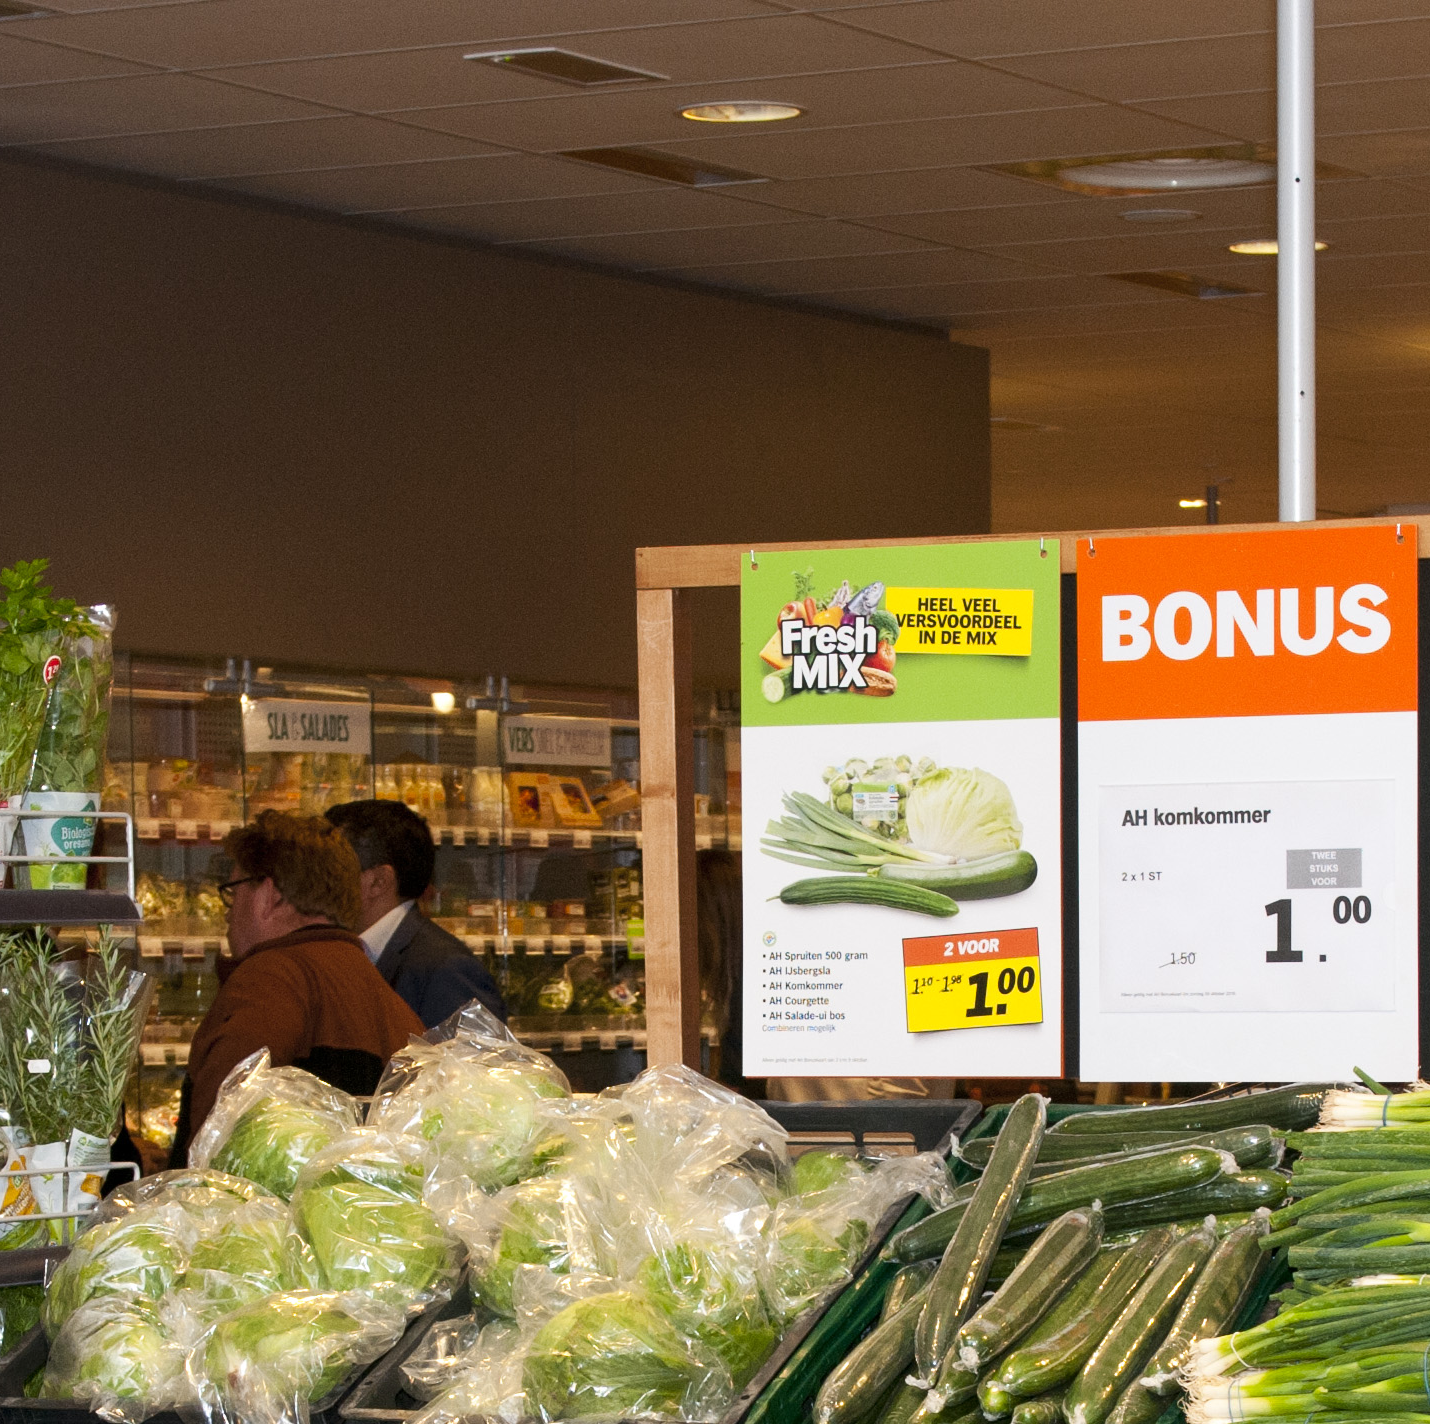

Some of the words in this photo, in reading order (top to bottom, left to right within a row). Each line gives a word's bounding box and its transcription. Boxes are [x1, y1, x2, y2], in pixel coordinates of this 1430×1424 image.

[918, 598, 957, 612] HEEL
[962, 598, 1001, 612] VEEL
[896, 614, 1022, 629] VERSVOORDEEL
[1101, 583, 1392, 662] BONUS
[780, 616, 877, 655] Fresh
[919, 630, 936, 644] IN
[941, 631, 961, 644] DE
[966, 631, 997, 645] MIX
[792, 653, 868, 689] MIX
[267, 712, 289, 740] SLA
[301, 713, 350, 742] SALADES
[507, 726, 534, 752] VERS
[1121, 810, 1148, 826] AH
[1154, 807, 1271, 826] komkommer
[1311, 851, 1337, 860] TWEE
[1309, 864, 1339, 873] STUKS
[1121, 872, 1128, 881] 2
[1148, 871, 1162, 881] ST
[1311, 877, 1337, 886] VOOR
[943, 941, 954, 956] 2
[957, 938, 1000, 955] VOOR
[769, 952, 782, 960] AH
[785, 951, 823, 963] Spruiten
[825, 951, 842, 960] 500
[845, 952, 868, 962] gram
[769, 967, 782, 975] AH
[785, 966, 831, 977] IJsbergsla
[769, 982, 782, 990] AH
[785, 981, 843, 990] Komkommer
[965, 966, 1036, 1018] 1.00
[769, 997, 782, 1005] AH
[785, 996, 829, 1007] Courgette
[769, 1012, 782, 1020] AH
[785, 1011, 827, 1020] Salade-ui
[830, 1011, 845, 1020] bos
[762, 1024, 805, 1032] Combineren
[807, 1023, 836, 1033] mogelijk
